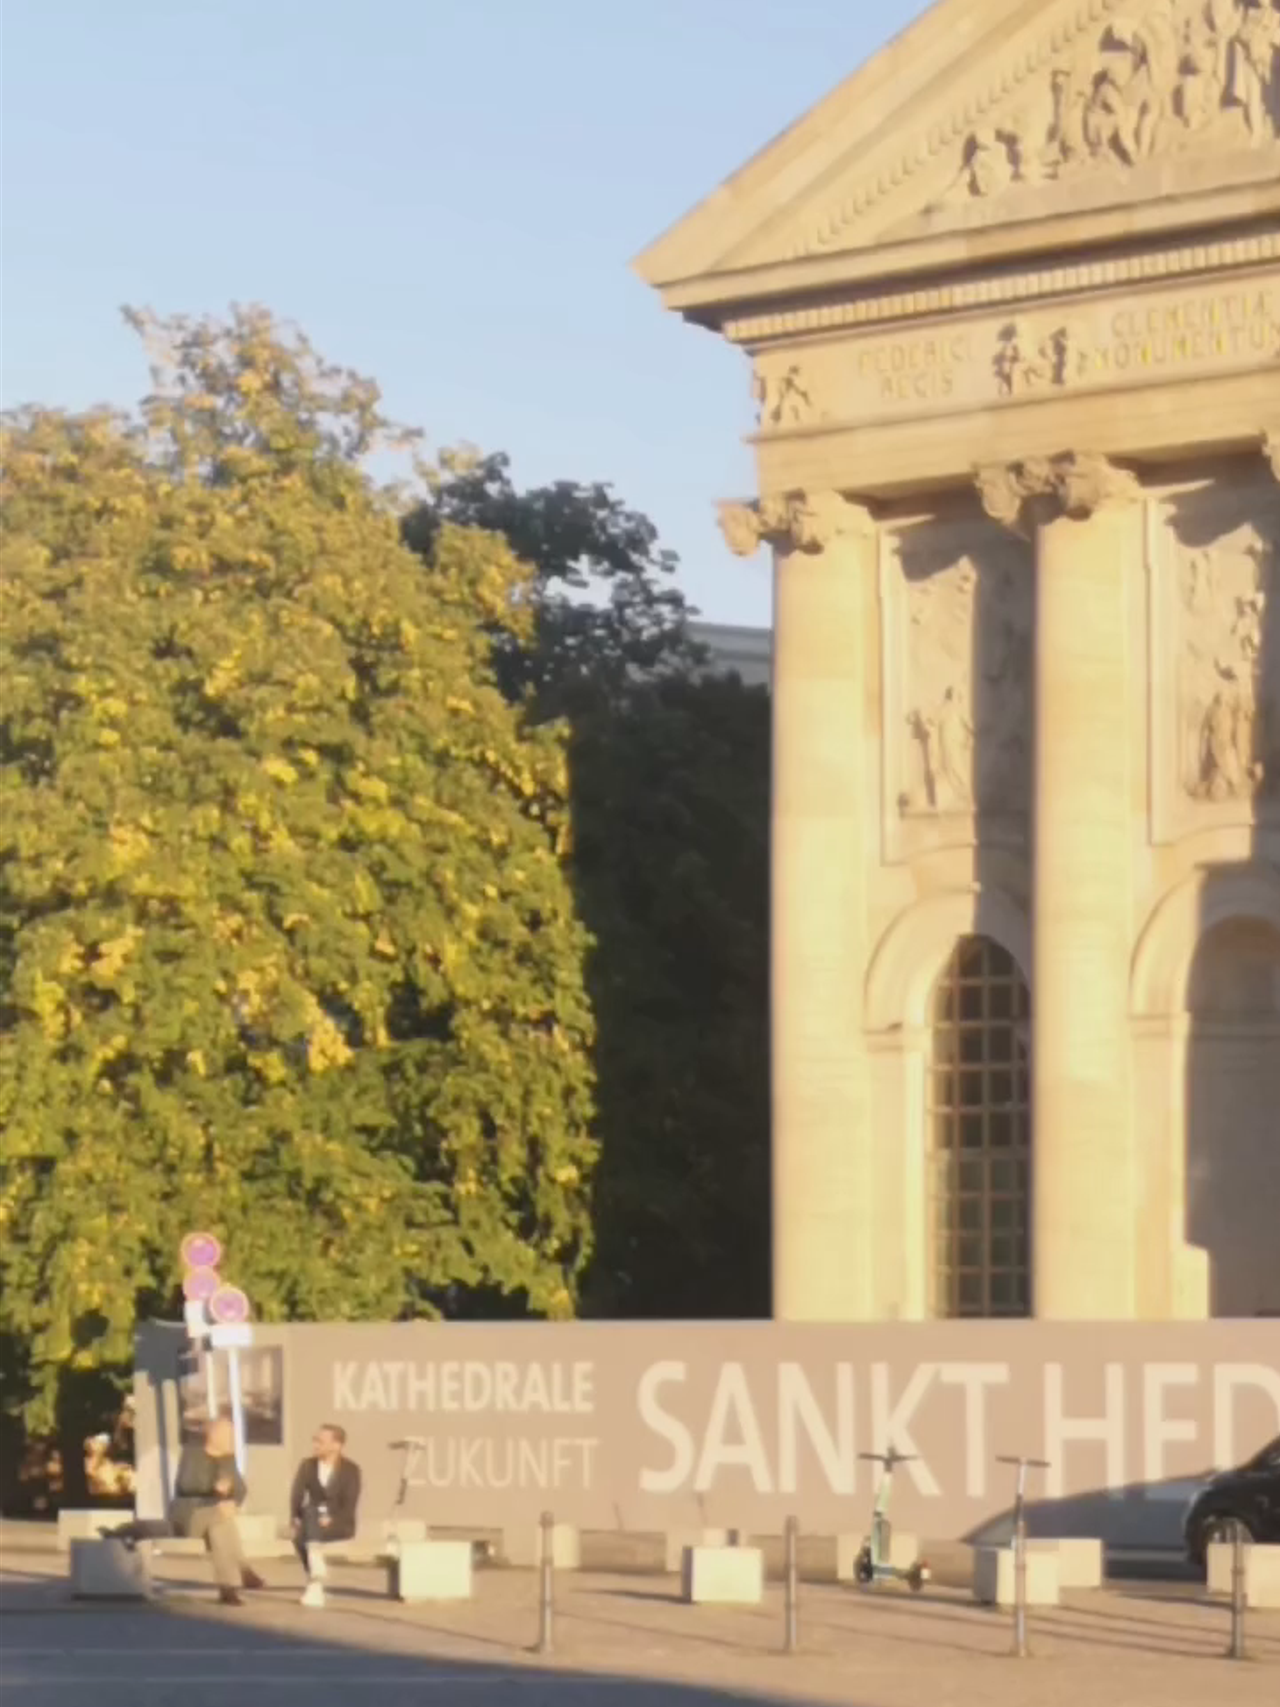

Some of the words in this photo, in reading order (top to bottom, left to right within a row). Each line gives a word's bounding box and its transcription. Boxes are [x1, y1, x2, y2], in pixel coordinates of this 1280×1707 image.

[333, 1361, 595, 1412] KATHEDRALE
[637, 1360, 1010, 1499] SANKT
[404, 1436, 599, 1490] ZUKUNFT
